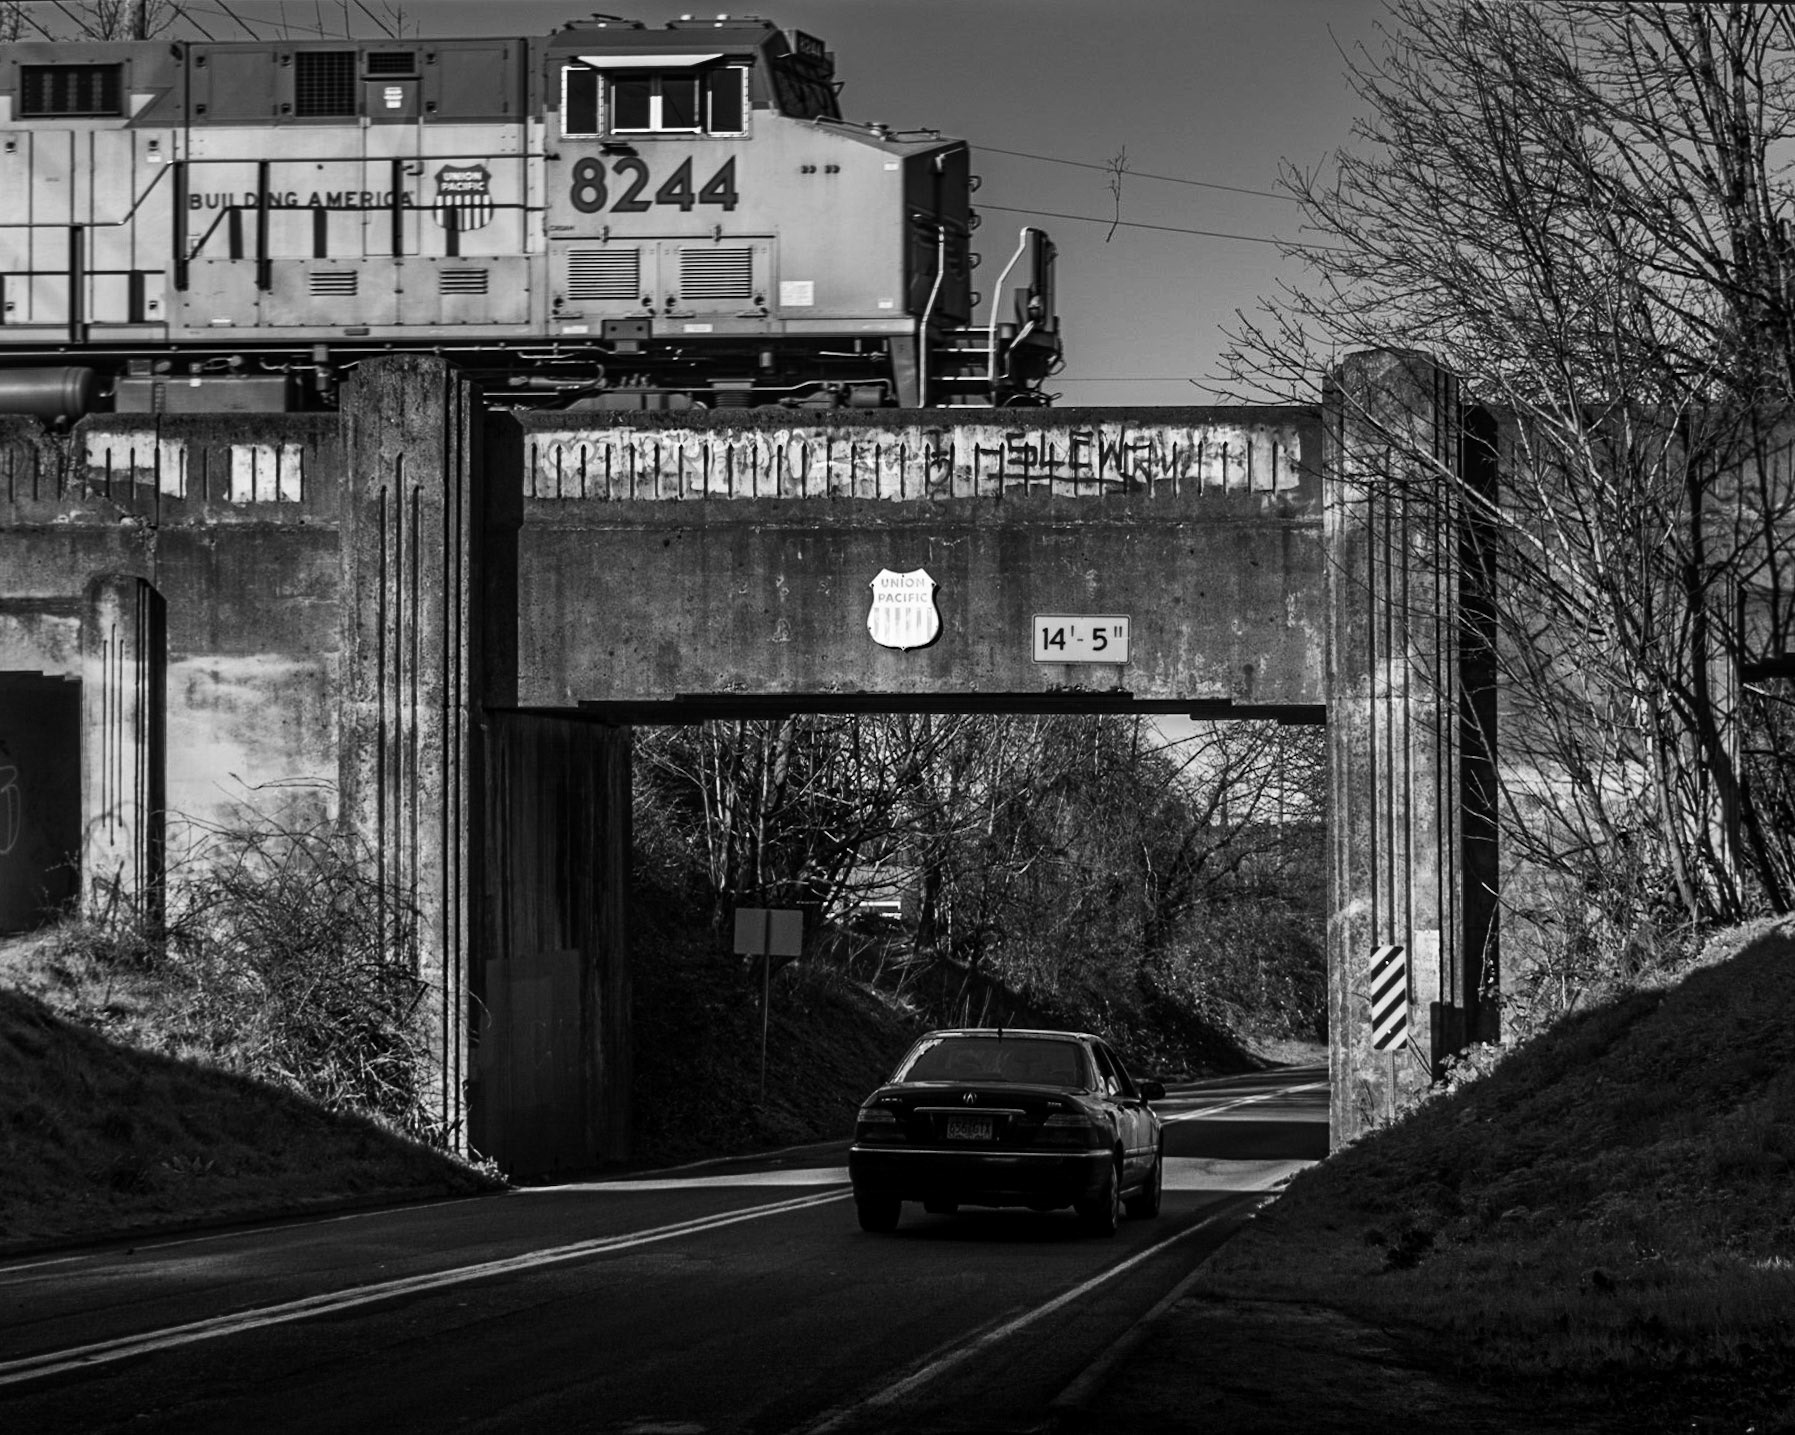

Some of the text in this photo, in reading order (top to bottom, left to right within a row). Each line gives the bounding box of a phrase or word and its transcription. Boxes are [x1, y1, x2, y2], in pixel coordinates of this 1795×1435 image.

[443, 171, 482, 181] UNION
[440, 181, 485, 191] PACIFIC
[570, 155, 739, 213] 8244
[189, 191, 298, 211] BUILDNG
[880, 577, 926, 589] UNION
[877, 592, 928, 604] PACIFIC
